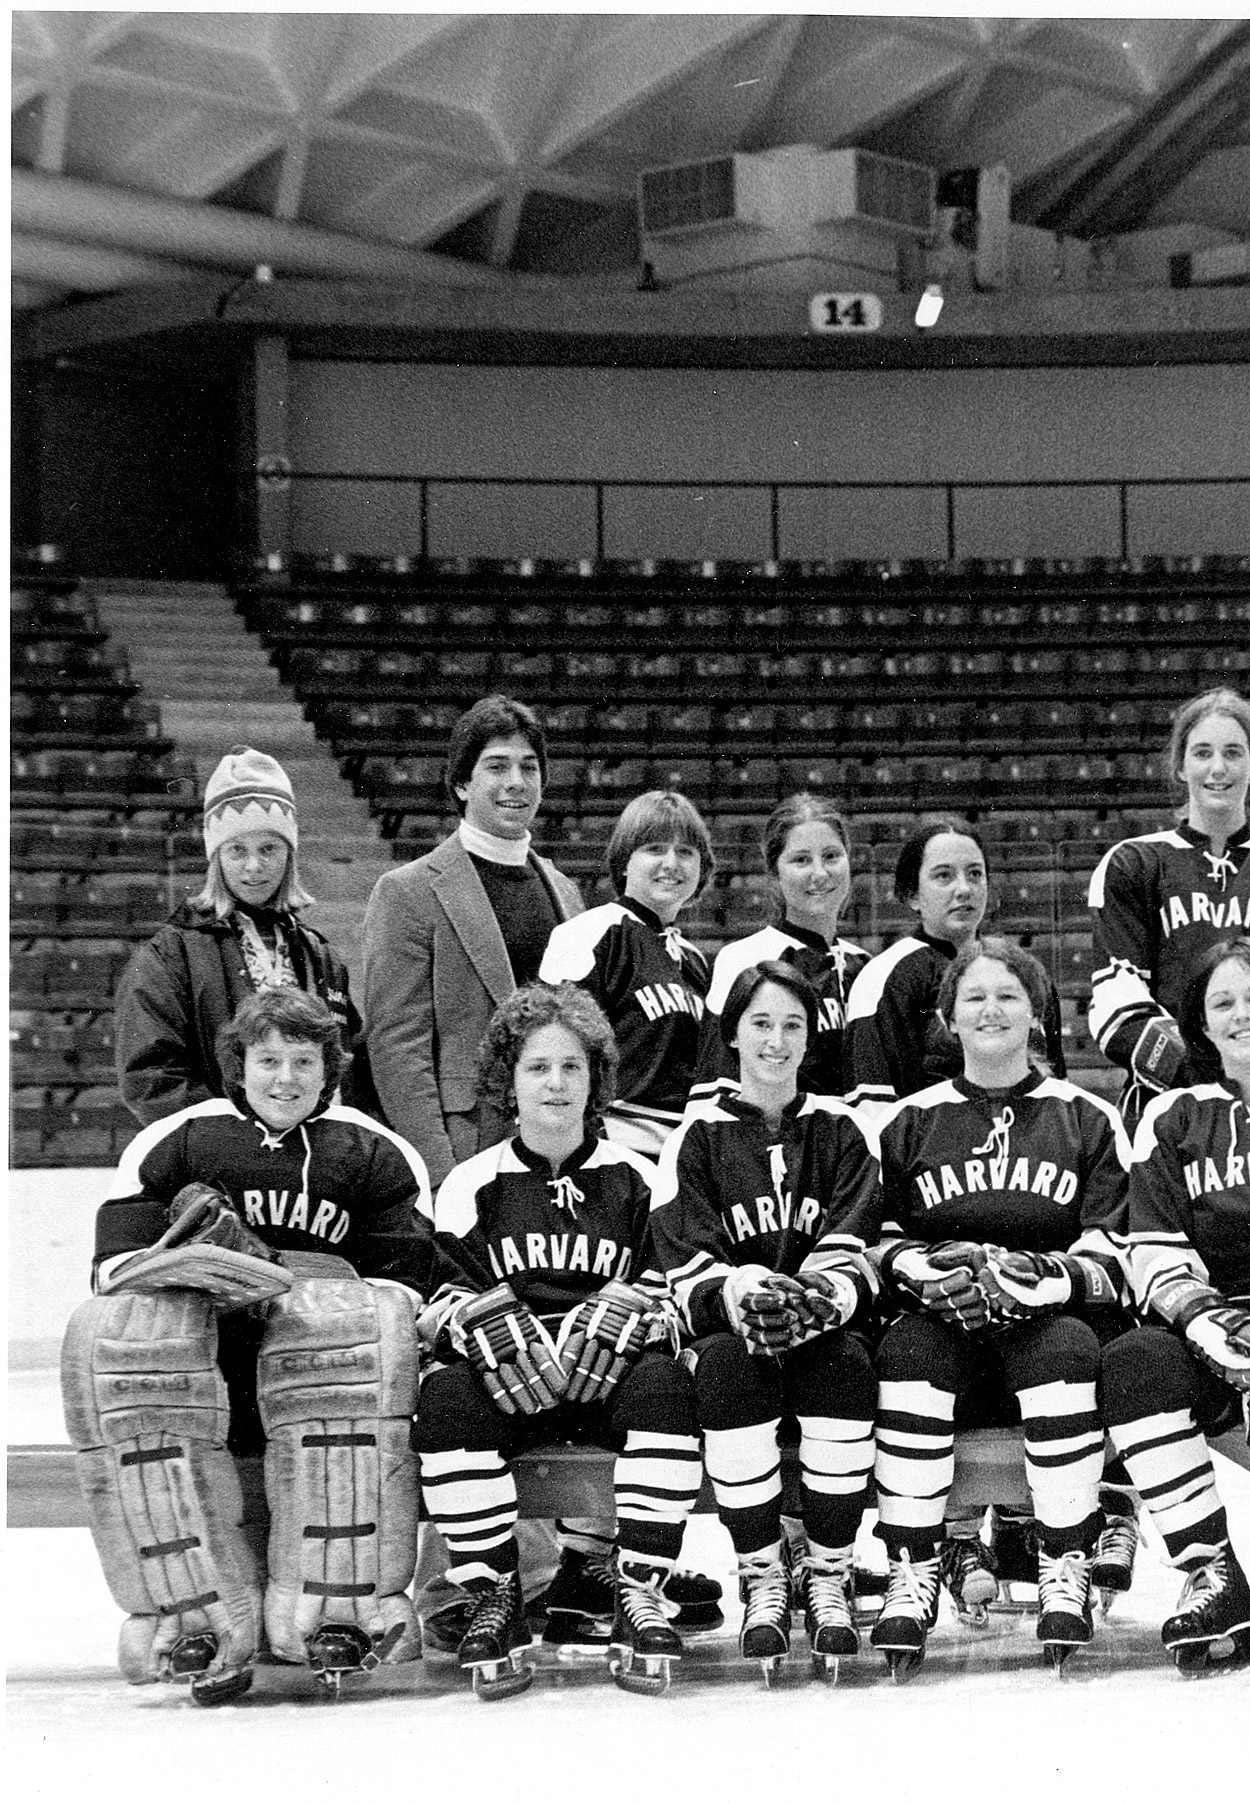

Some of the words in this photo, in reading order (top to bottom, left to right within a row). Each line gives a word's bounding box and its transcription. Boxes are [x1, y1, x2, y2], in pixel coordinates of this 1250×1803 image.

[824, 299, 866, 326] 14
[915, 1157, 1077, 1210] HARVARD
[243, 1189, 350, 1245] RVARD
